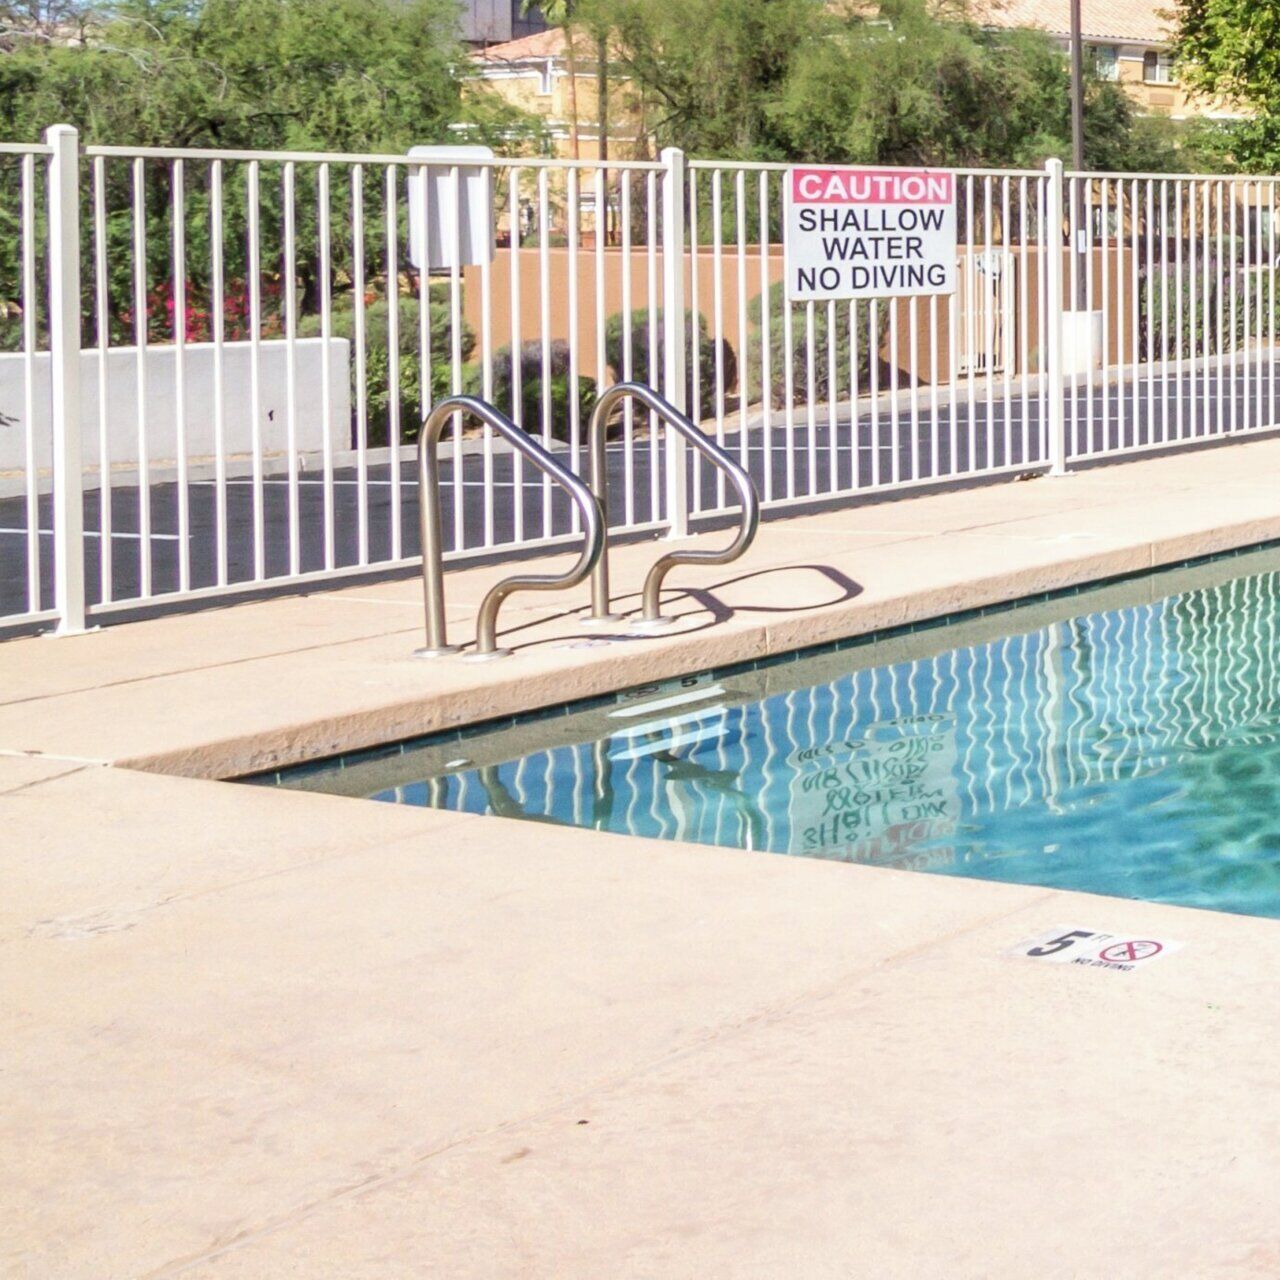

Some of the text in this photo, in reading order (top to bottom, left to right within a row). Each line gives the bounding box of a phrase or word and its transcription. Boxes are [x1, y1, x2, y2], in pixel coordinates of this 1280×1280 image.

[798, 174, 948, 201] CAUTION
[798, 208, 945, 232] SHALLOW
[822, 236, 924, 261] WATER
[797, 263, 947, 292] NO DIVING
[1026, 930, 1096, 957] 5
